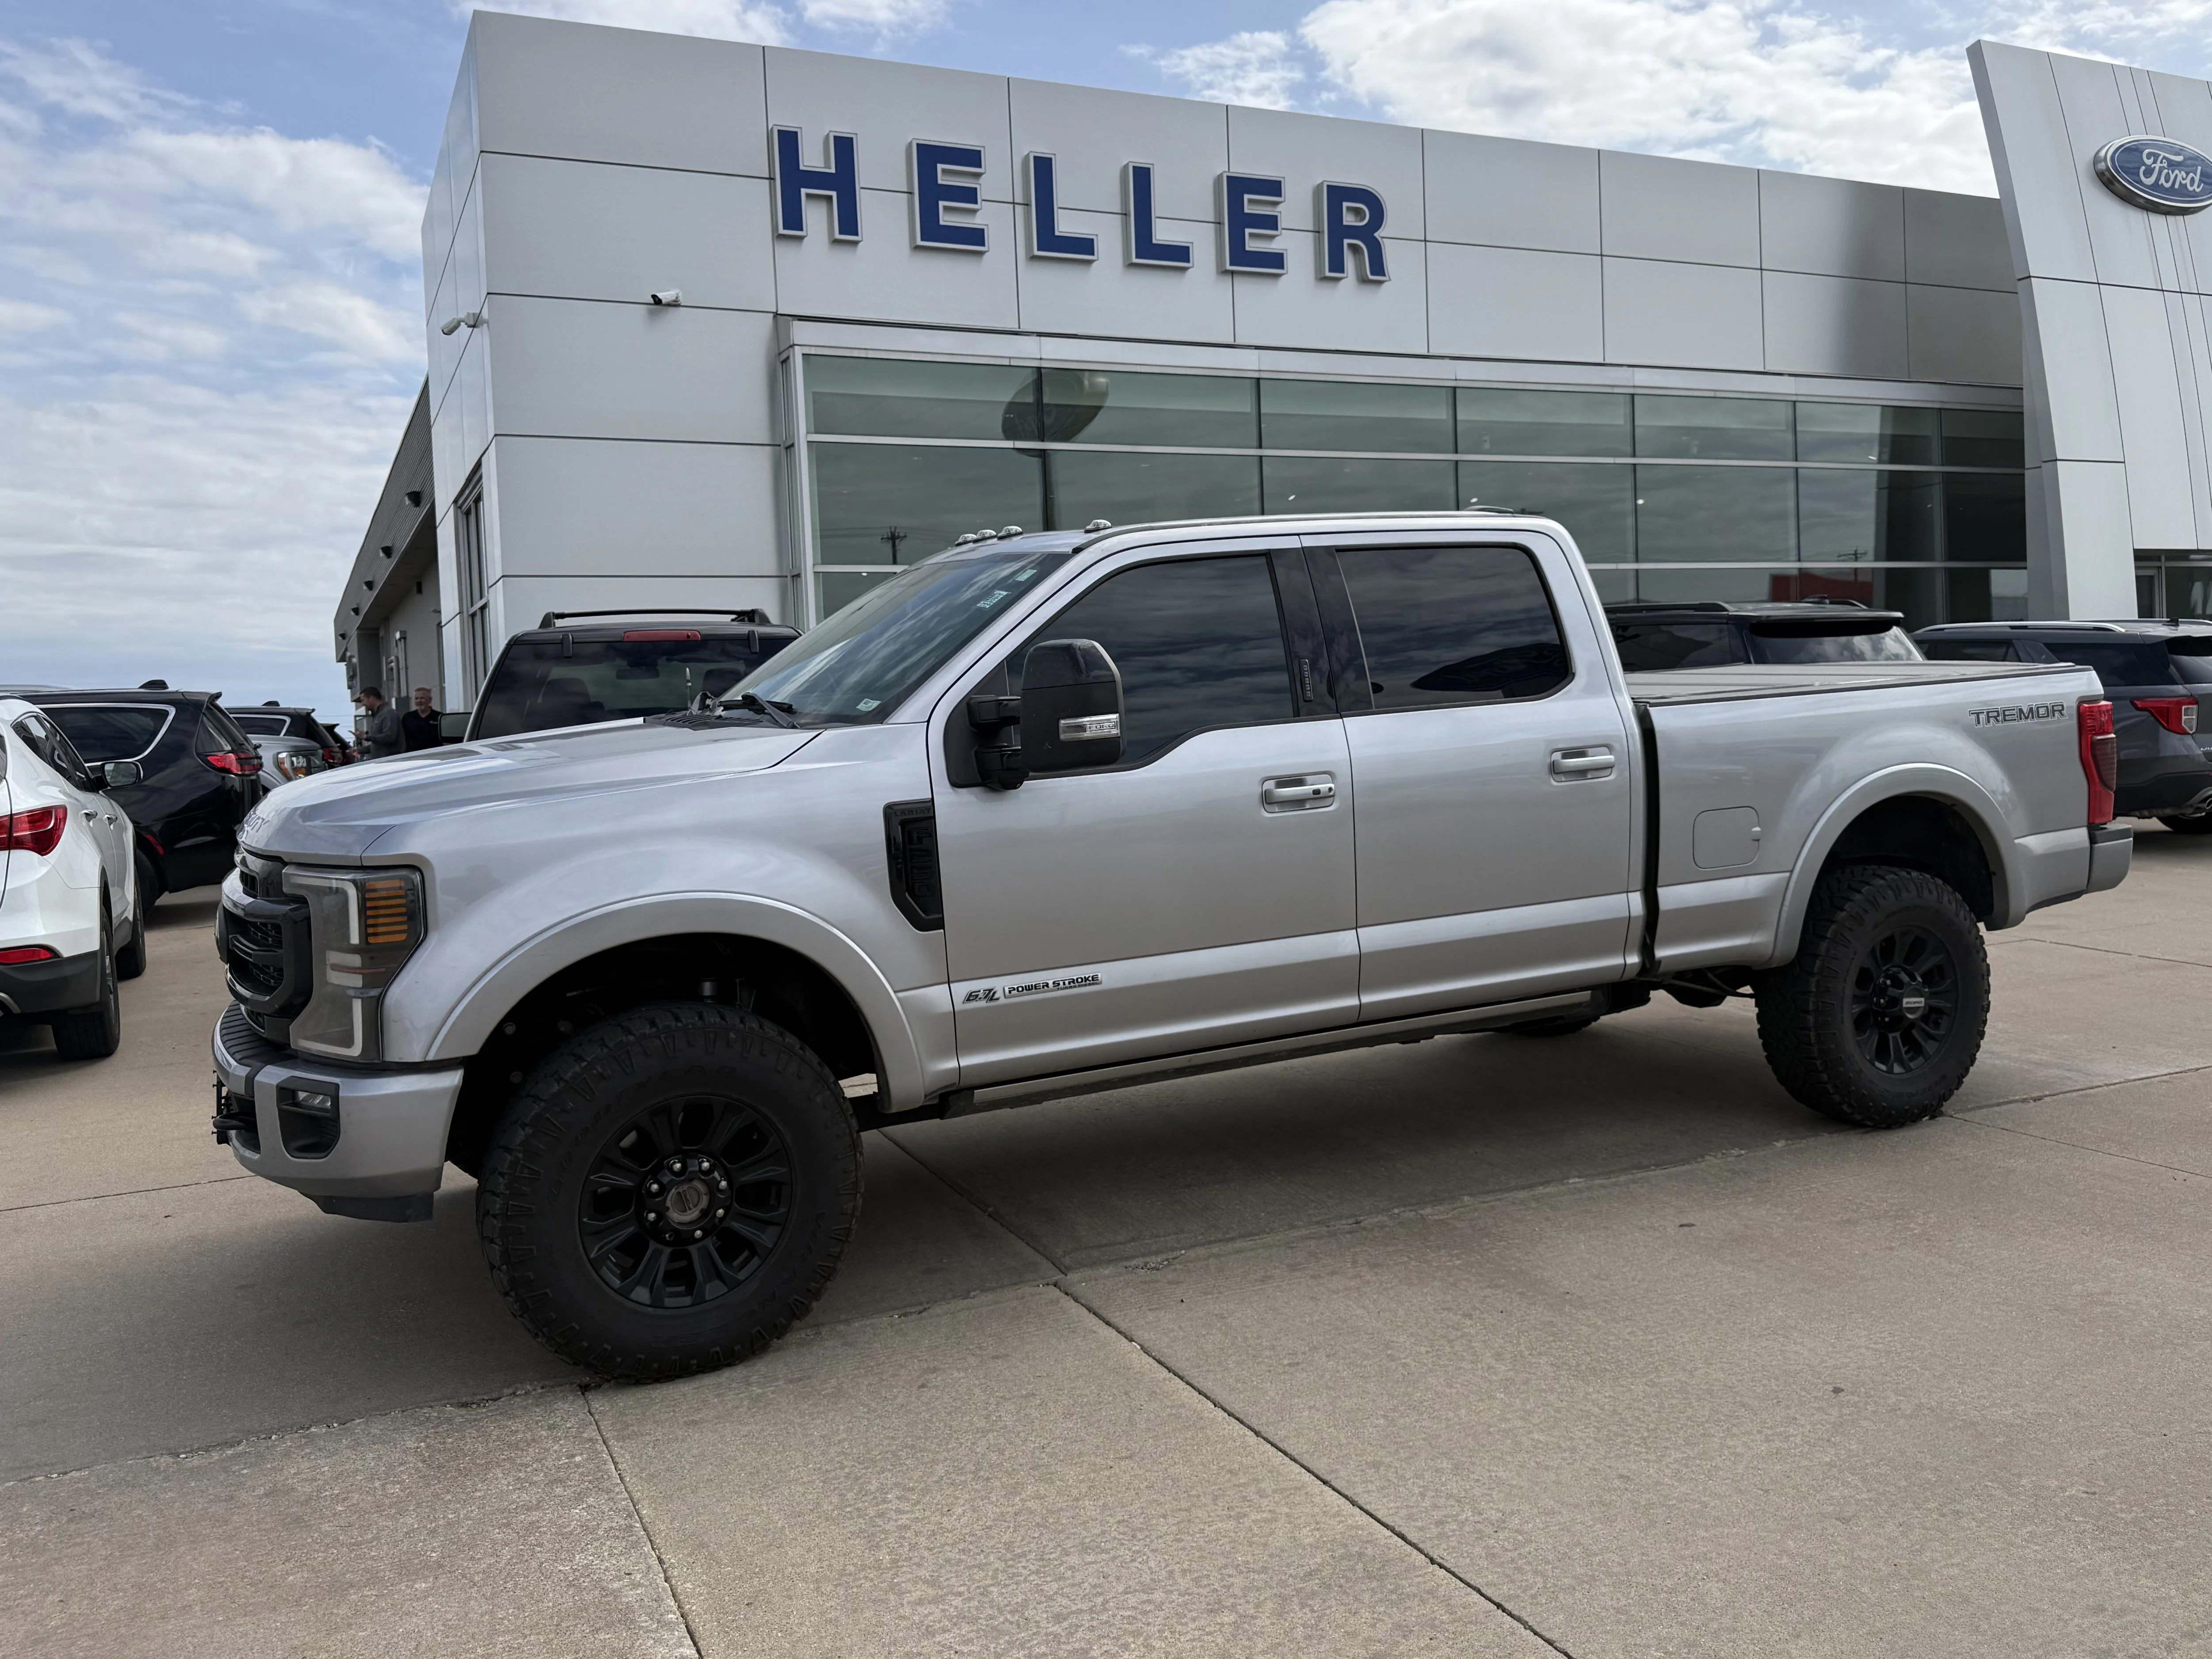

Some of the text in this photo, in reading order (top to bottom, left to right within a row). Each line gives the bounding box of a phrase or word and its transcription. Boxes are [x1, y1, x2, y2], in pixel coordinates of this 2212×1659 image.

[2139, 149, 2204, 192] Ford
[770, 125, 1391, 282] HELLER
[1969, 701, 2068, 727] TREMOR
[894, 808, 931, 817] LARIAT
[963, 974, 1099, 1003] 6.7L POWER STROKE
